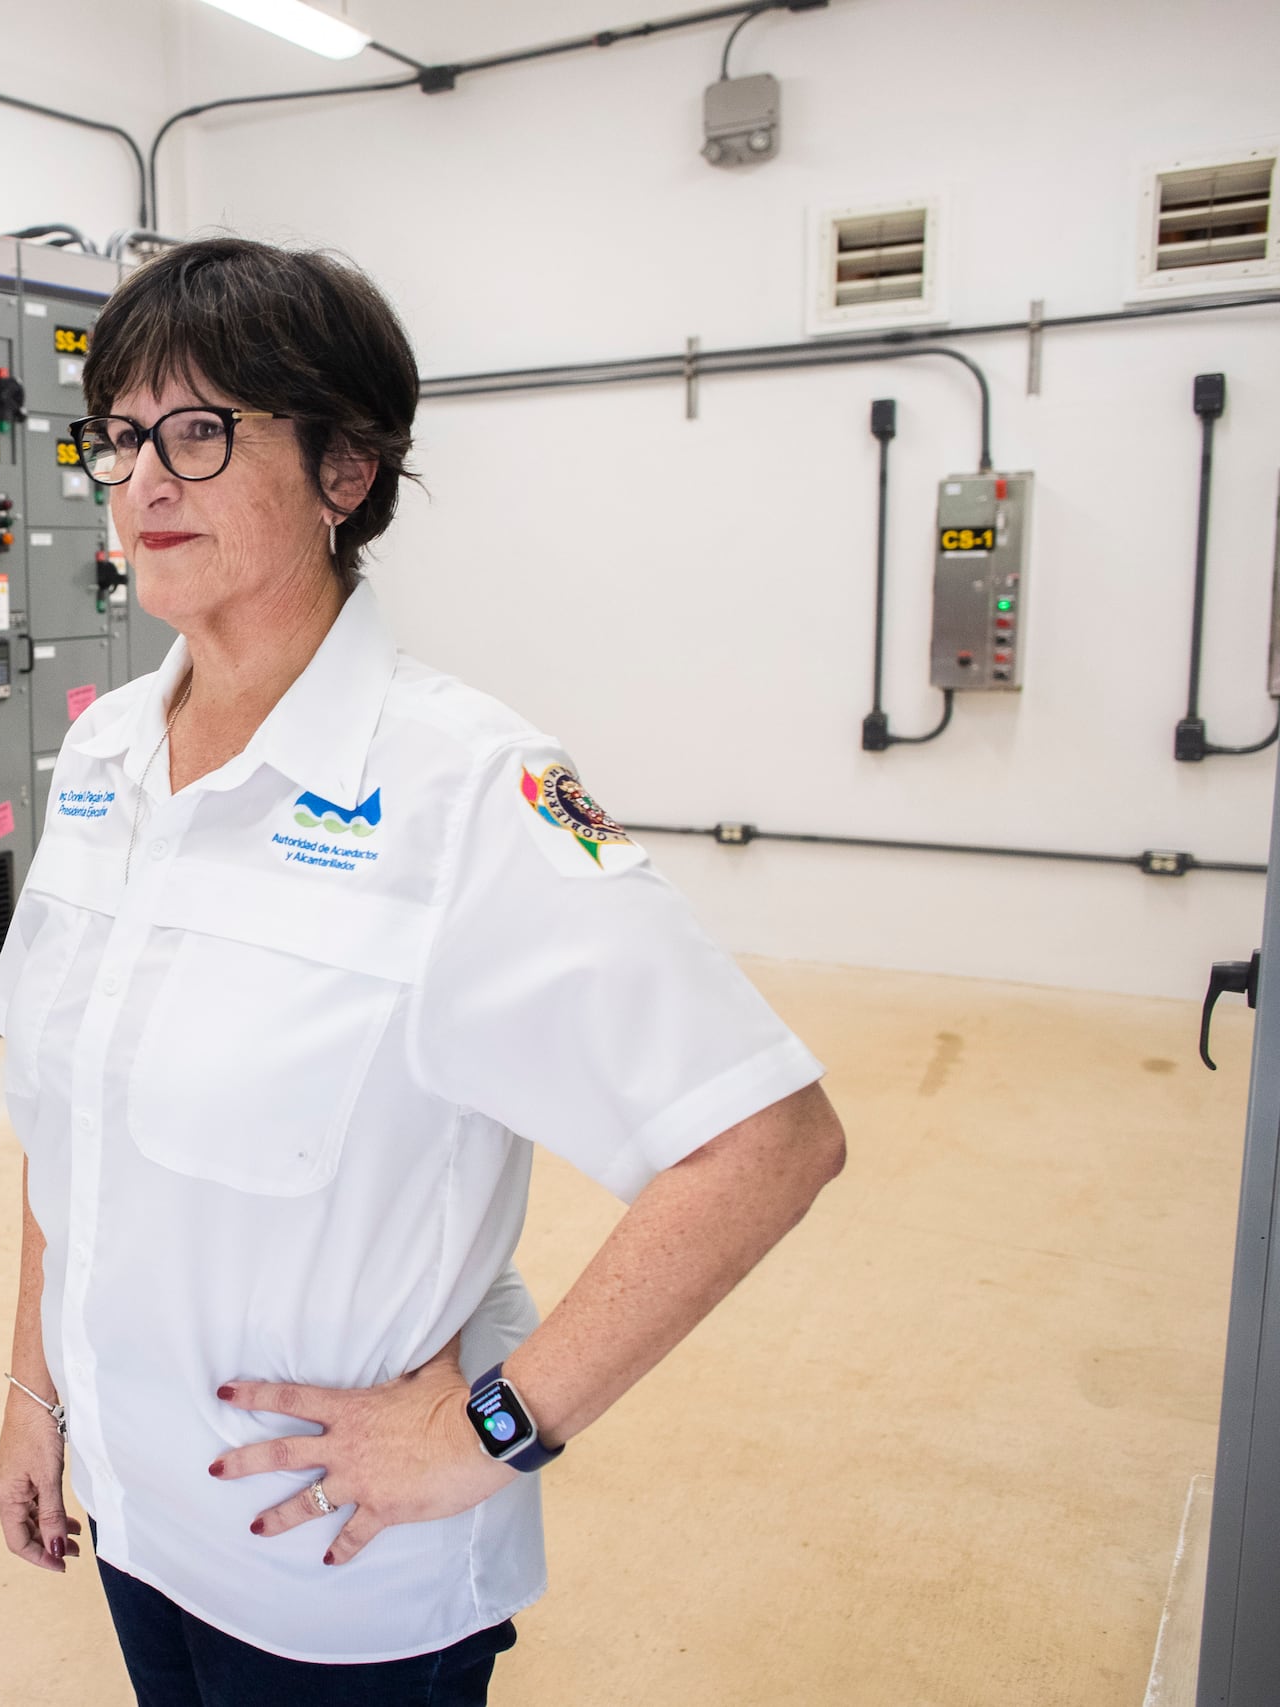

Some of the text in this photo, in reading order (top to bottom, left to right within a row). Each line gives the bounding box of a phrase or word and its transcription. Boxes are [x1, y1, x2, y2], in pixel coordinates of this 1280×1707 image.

[942, 530, 993, 549] CS-1
[271, 833, 378, 861] Autoridad de Acueductos
[285, 851, 356, 871] y Alcantarillados
